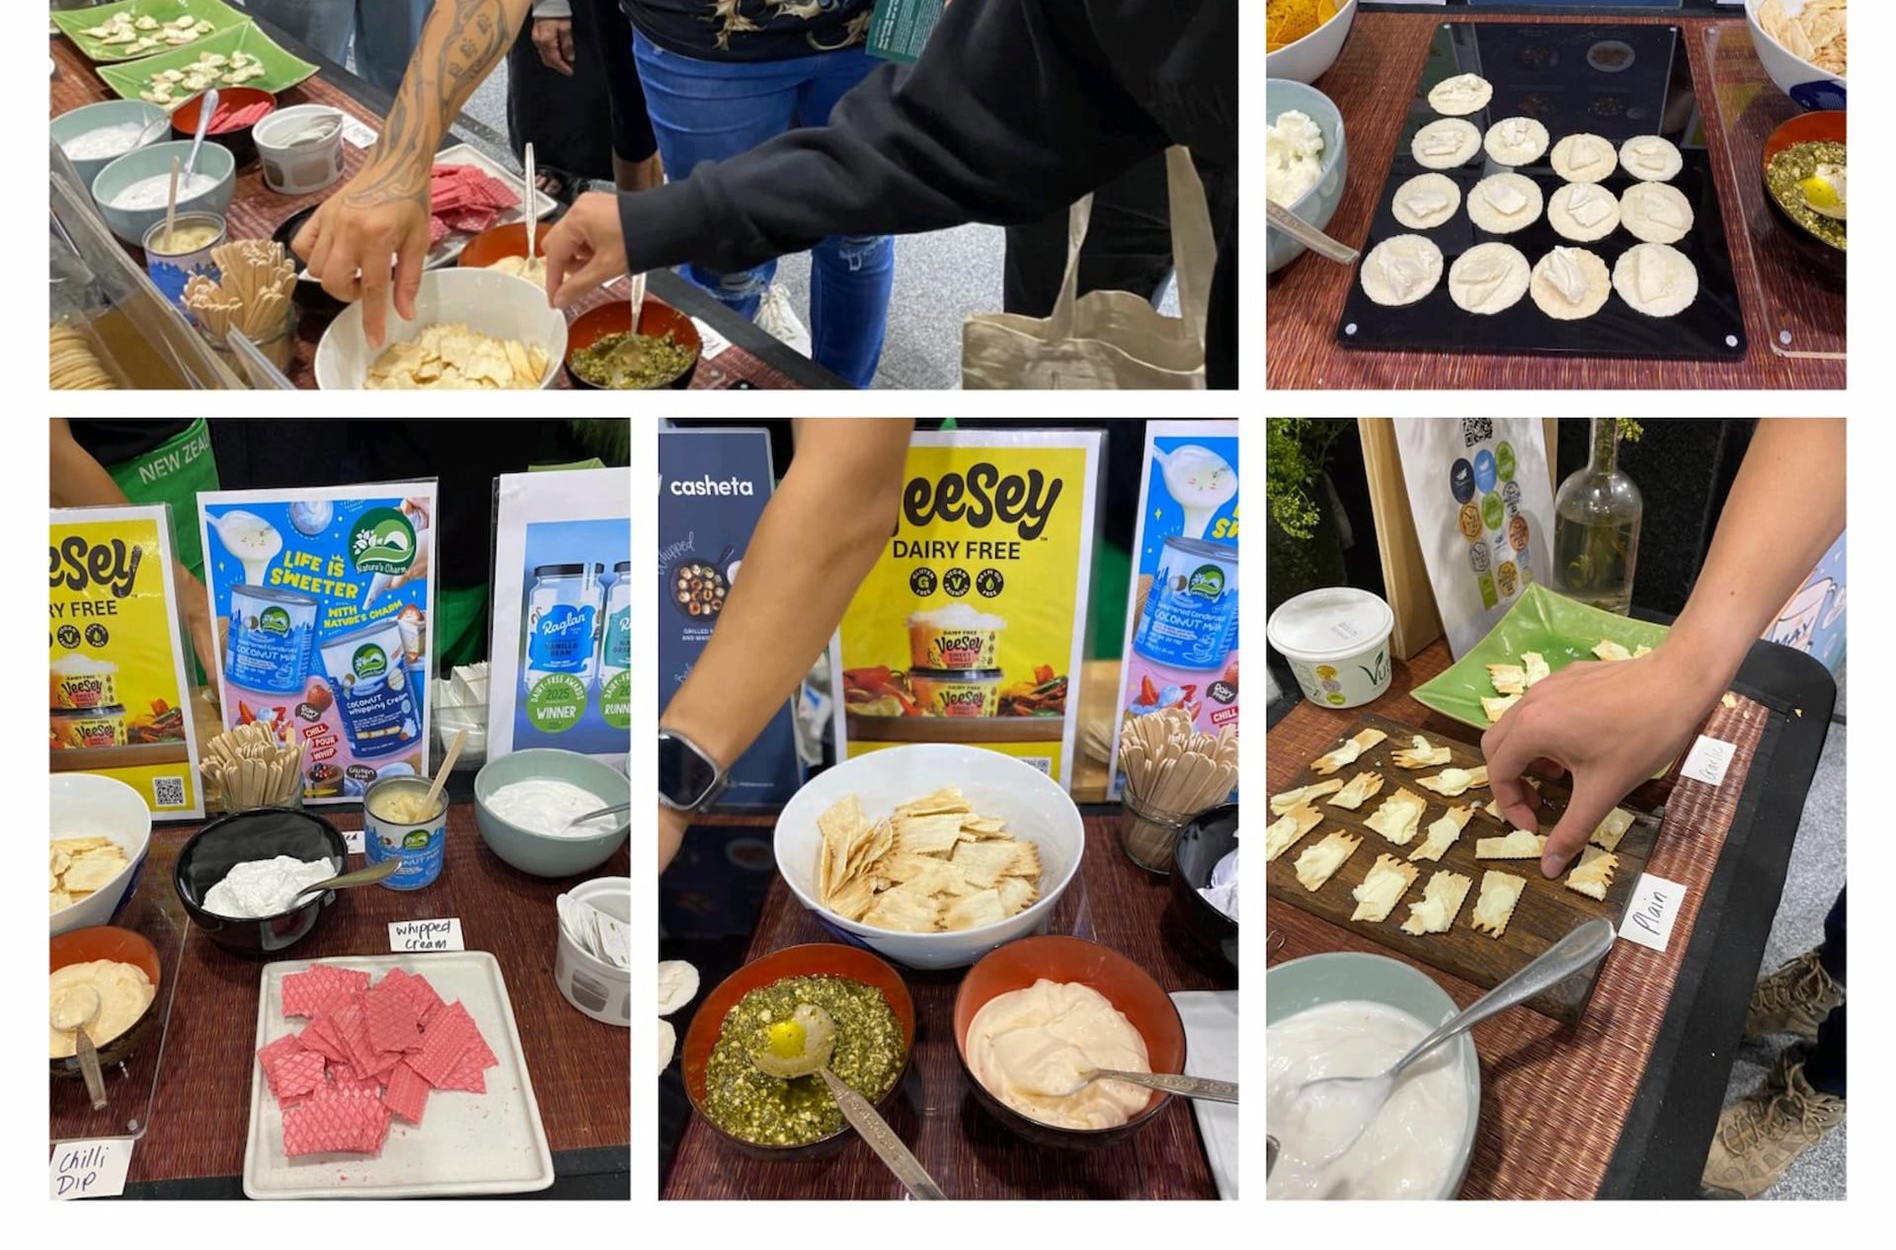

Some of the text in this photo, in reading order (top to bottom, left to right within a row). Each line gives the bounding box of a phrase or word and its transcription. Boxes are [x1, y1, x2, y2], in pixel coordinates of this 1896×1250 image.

[138, 451, 181, 485] NEW
[670, 475, 754, 497] casheta
[903, 462, 1063, 541] eeSey
[893, 540, 1021, 560] DAIRY FREE
[283, 550, 345, 578] LIFE IS
[356, 563, 407, 576] Nature's Charm
[270, 568, 359, 599] SWEETER
[918, 576, 930, 589] G
[951, 577, 962, 590] V
[71, 600, 118, 617] FREE
[324, 600, 403, 629] NATURE'S CHARM
[328, 605, 358, 618] WITH
[543, 612, 586, 636] Raglan
[1154, 609, 1201, 630] COCONUT
[935, 636, 984, 655] VeeSey
[346, 693, 382, 709] COCONUT
[546, 688, 570, 701] 2025
[939, 690, 987, 708] VeeSey
[348, 701, 386, 716] whipping
[536, 705, 577, 720] WINNER
[1213, 707, 1238, 723] CHILL
[305, 725, 326, 738] CHILL
[315, 736, 336, 747] POUR
[313, 748, 335, 761] WHIP
[1632, 890, 1668, 936] Plain
[396, 920, 451, 939] whipped
[59, 1145, 109, 1173] Chilli
